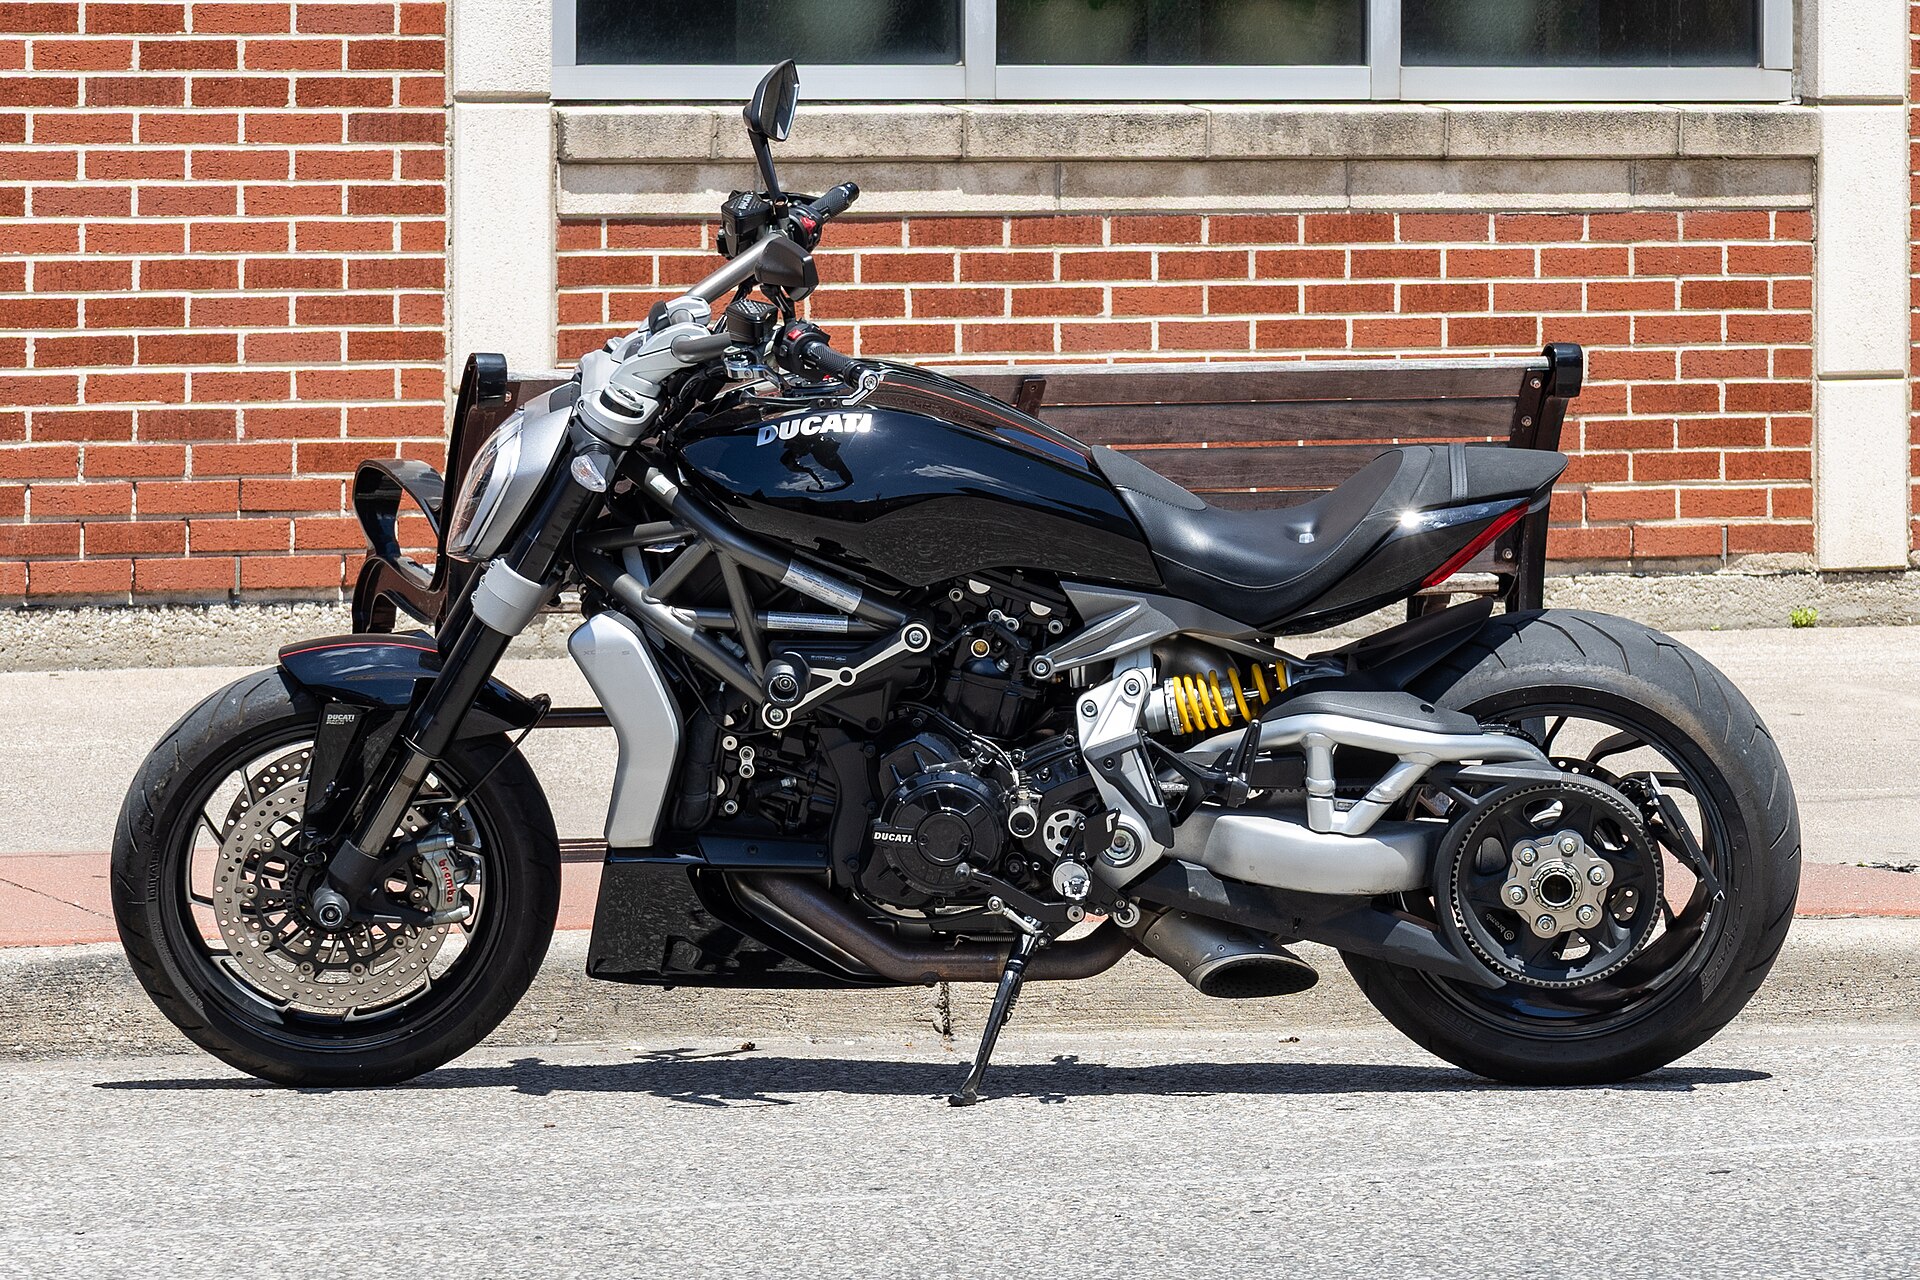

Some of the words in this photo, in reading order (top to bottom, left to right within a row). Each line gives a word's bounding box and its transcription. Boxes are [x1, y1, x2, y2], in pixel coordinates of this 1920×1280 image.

[756, 413, 873, 447] DUCATI
[873, 831, 912, 843] DUCATI
[438, 858, 456, 903] brembo
